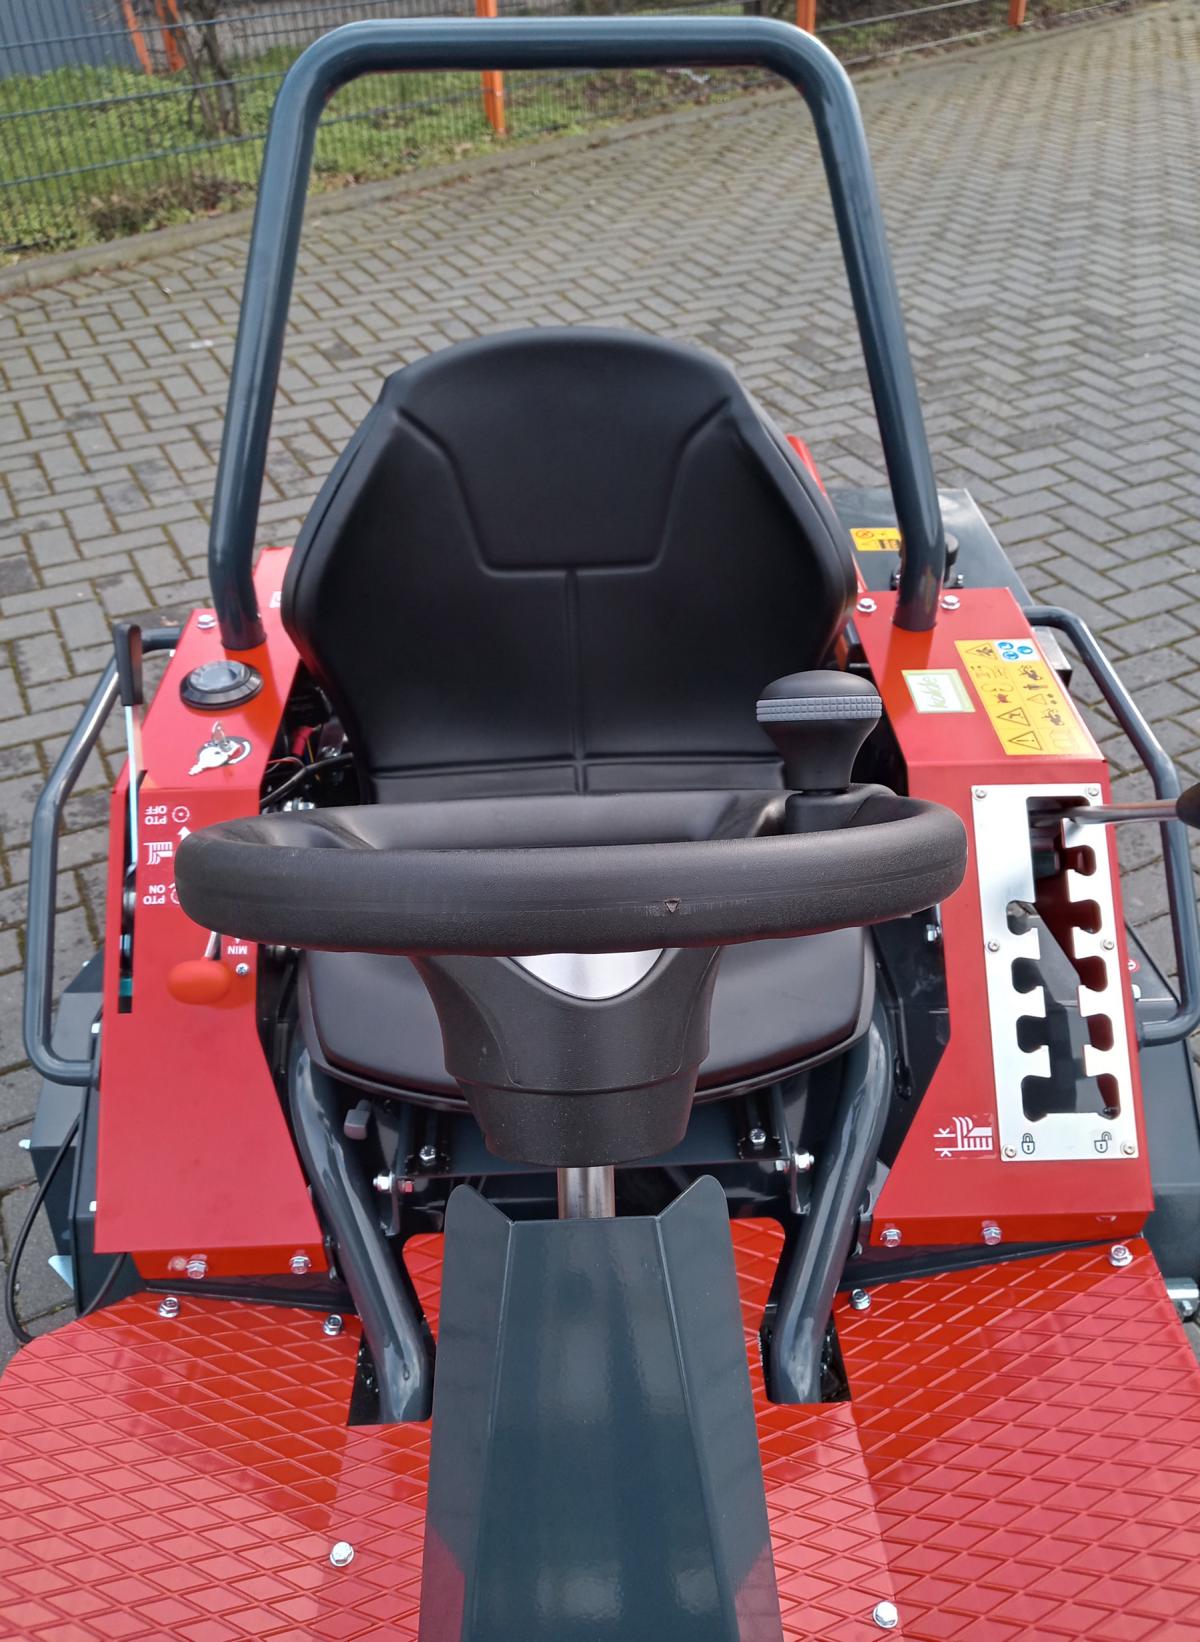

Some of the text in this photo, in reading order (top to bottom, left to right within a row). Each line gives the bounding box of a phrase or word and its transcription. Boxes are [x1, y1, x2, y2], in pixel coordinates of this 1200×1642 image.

[145, 805, 168, 815] OFF
[144, 815, 168, 825] PTO
[148, 884, 166, 894] ON
[142, 895, 166, 905] PTO
[226, 946, 248, 956] MIN
